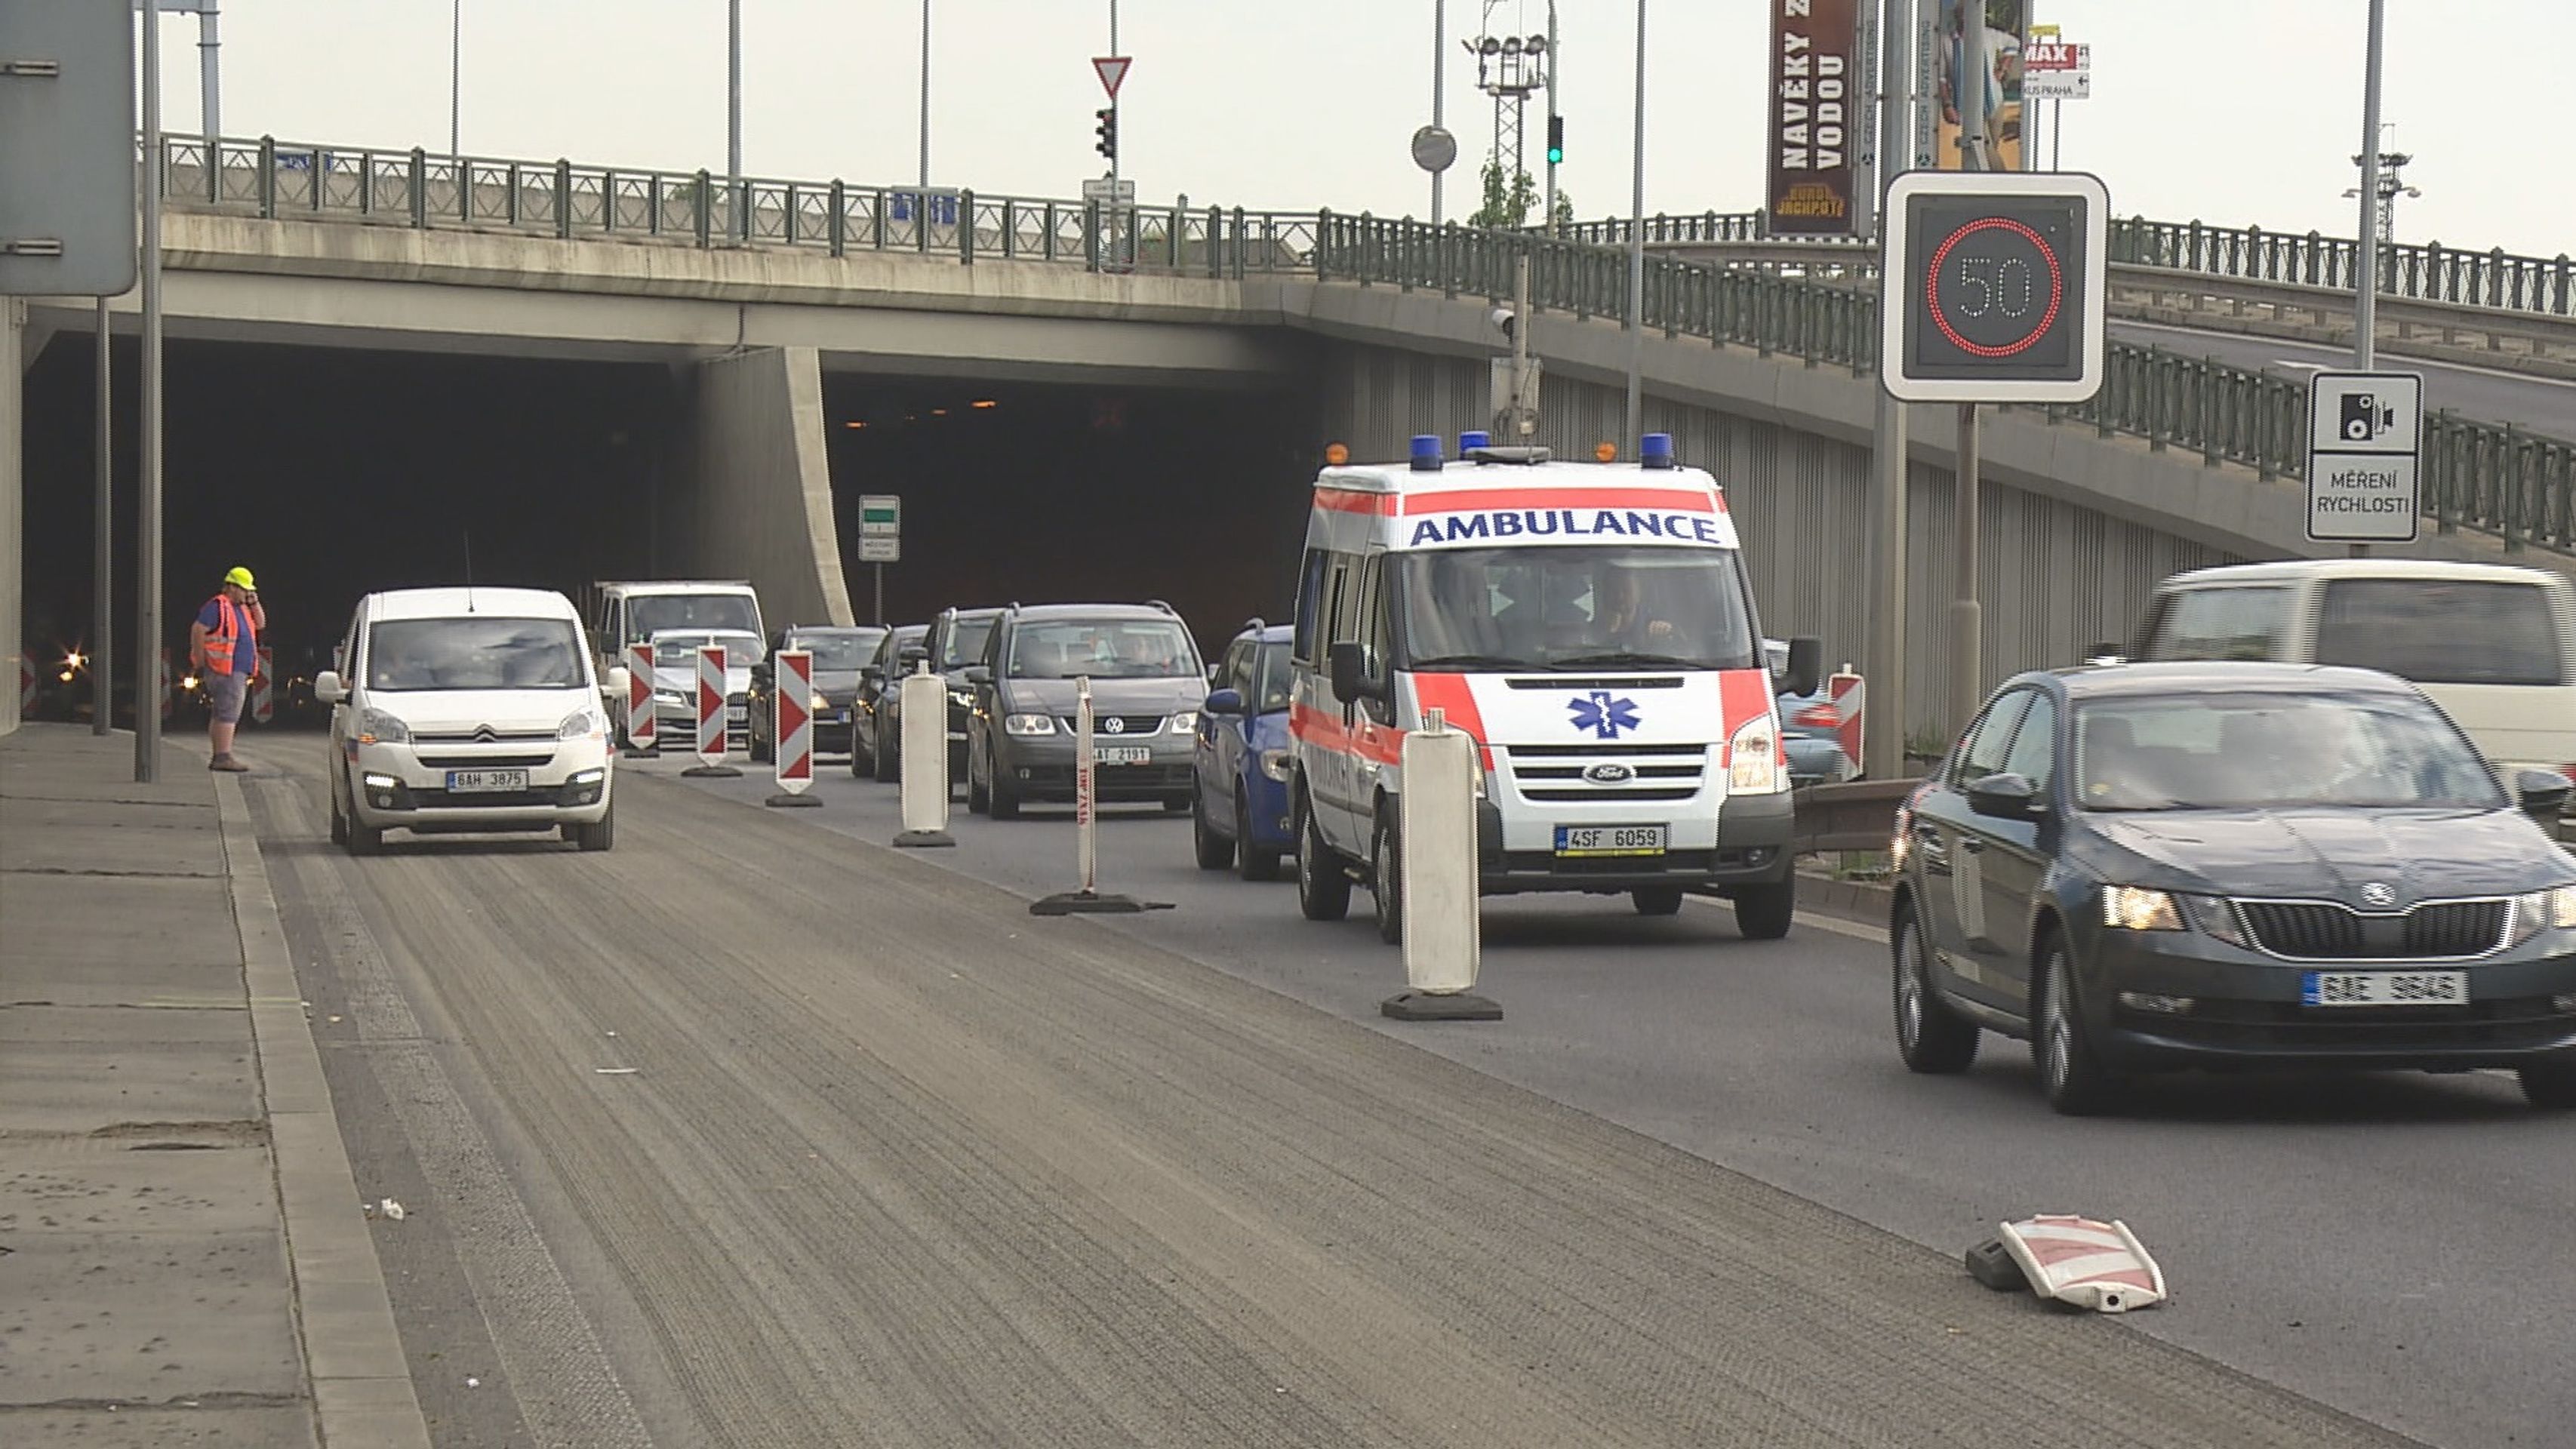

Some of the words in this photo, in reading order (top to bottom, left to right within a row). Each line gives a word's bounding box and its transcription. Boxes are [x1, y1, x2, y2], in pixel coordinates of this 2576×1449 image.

[1865, 20, 1876, 99] ADVERTISING
[1921, 20, 1931, 98] ADVERTISING
[1779, 32, 1810, 169] NAVĚKY
[1817, 54, 1843, 170] VODOU
[1864, 104, 1875, 144] CZECH
[1919, 105, 1930, 144] CZECH
[1960, 257, 2030, 318] 50
[2331, 470, 2397, 488] MĚŘENÍ
[2317, 497, 2409, 512] RYCHLOSTI
[1410, 510, 1720, 546] AMBULANCE
[457, 774, 482, 786] 6AH
[1571, 830, 1602, 848] 4SF
[1614, 829, 1657, 847] 6059
[2324, 976, 2374, 1001] 6AE
[2390, 976, 2456, 1000] 9646
